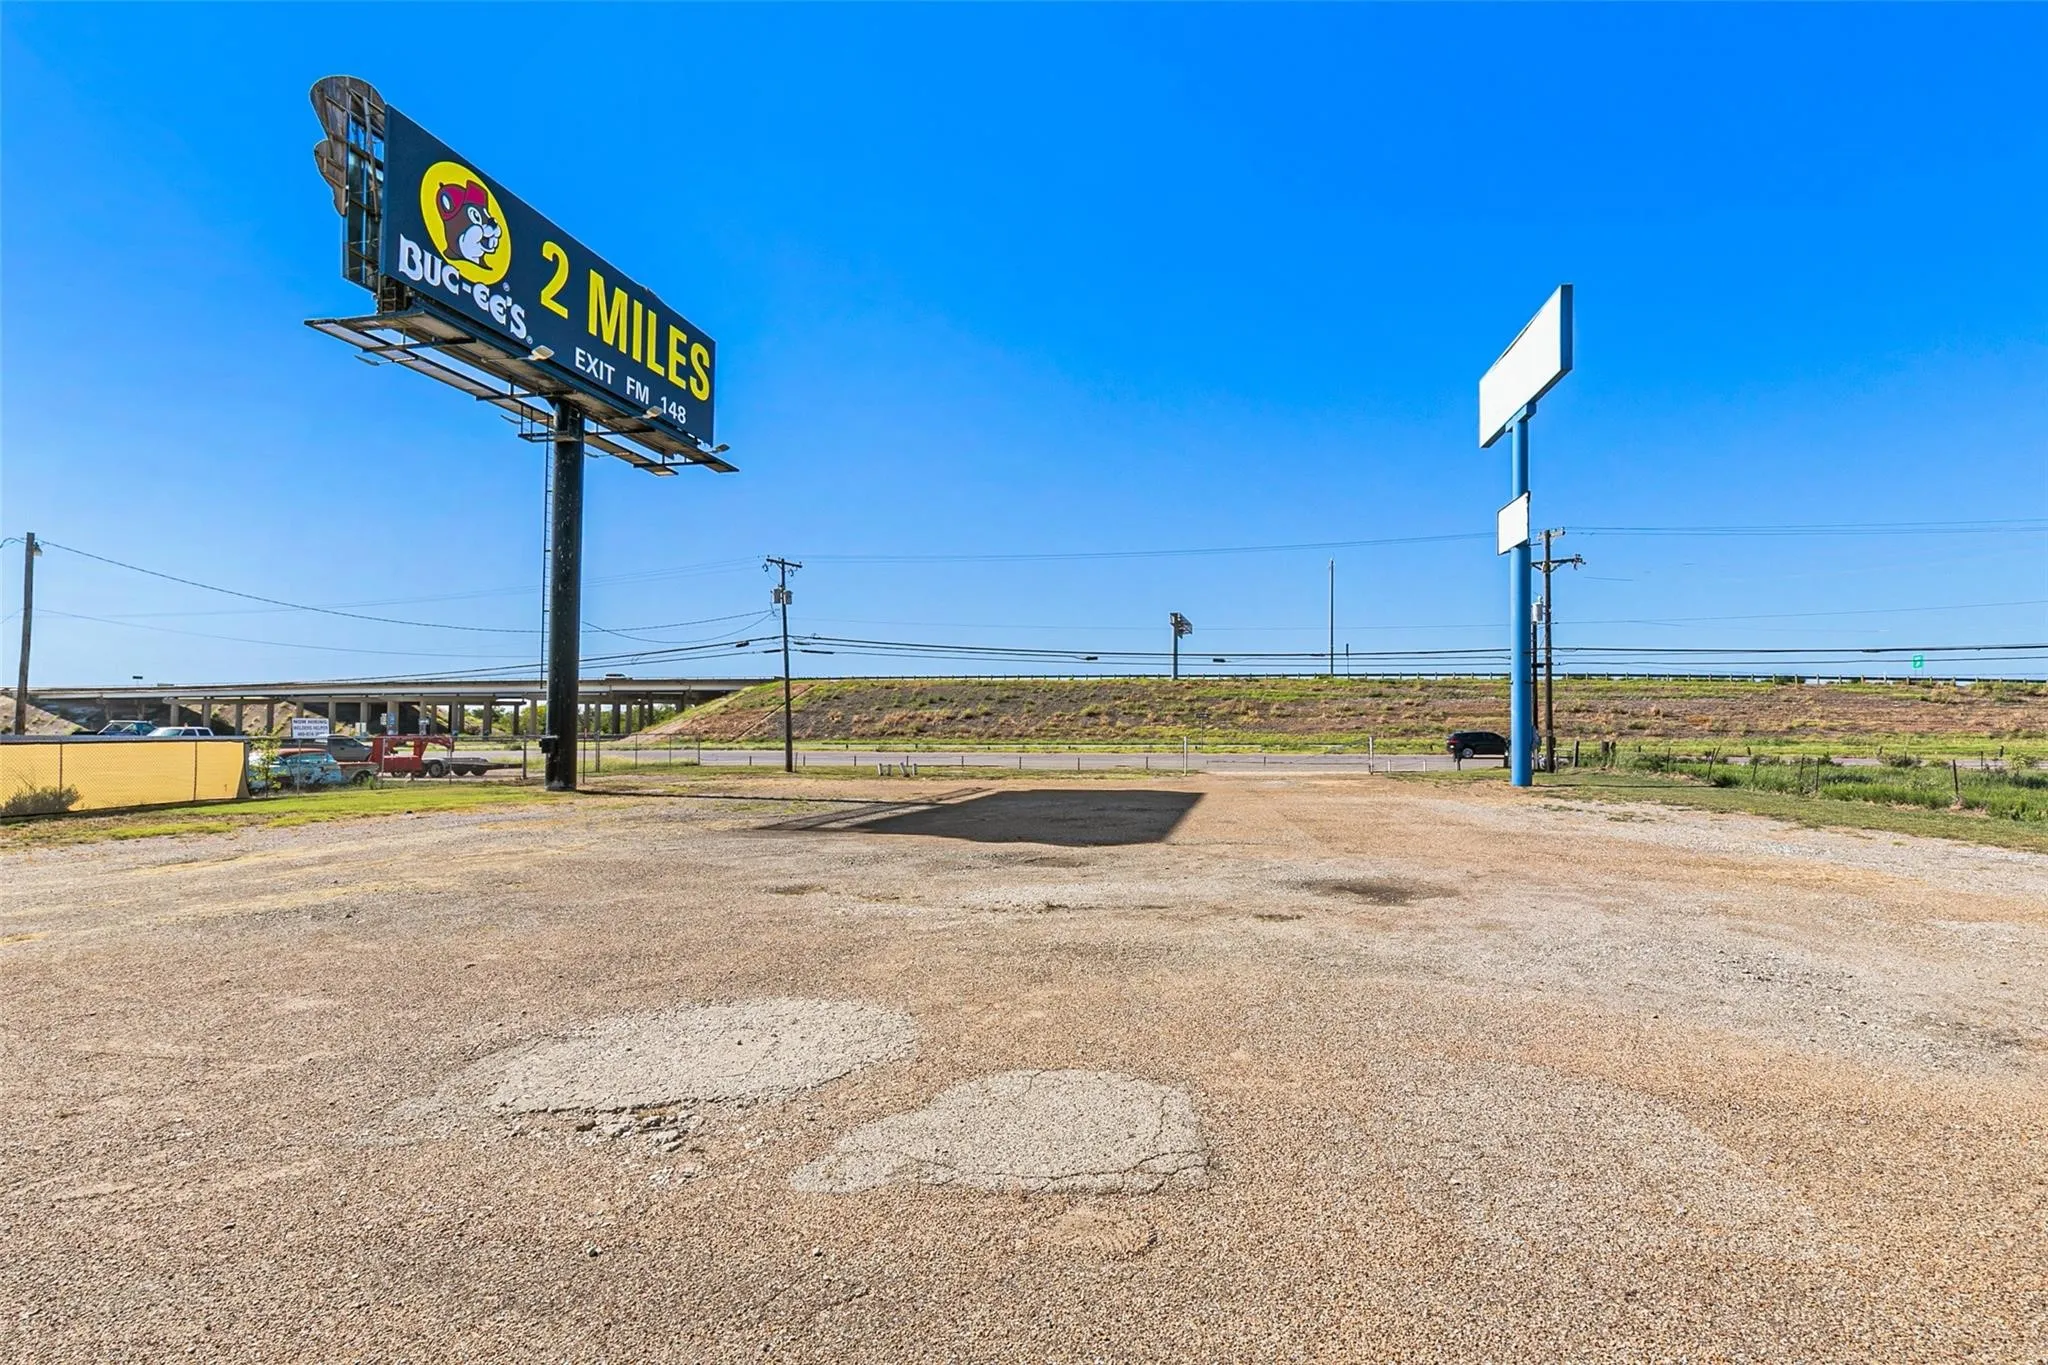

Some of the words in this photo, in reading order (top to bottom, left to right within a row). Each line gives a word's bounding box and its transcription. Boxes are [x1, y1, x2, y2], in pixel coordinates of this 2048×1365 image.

[540, 240, 570, 320] 2
[588, 268, 710, 402] MILES
[575, 346, 616, 385] EXIT
[626, 375, 650, 405] FM
[660, 396, 687, 425] 148
